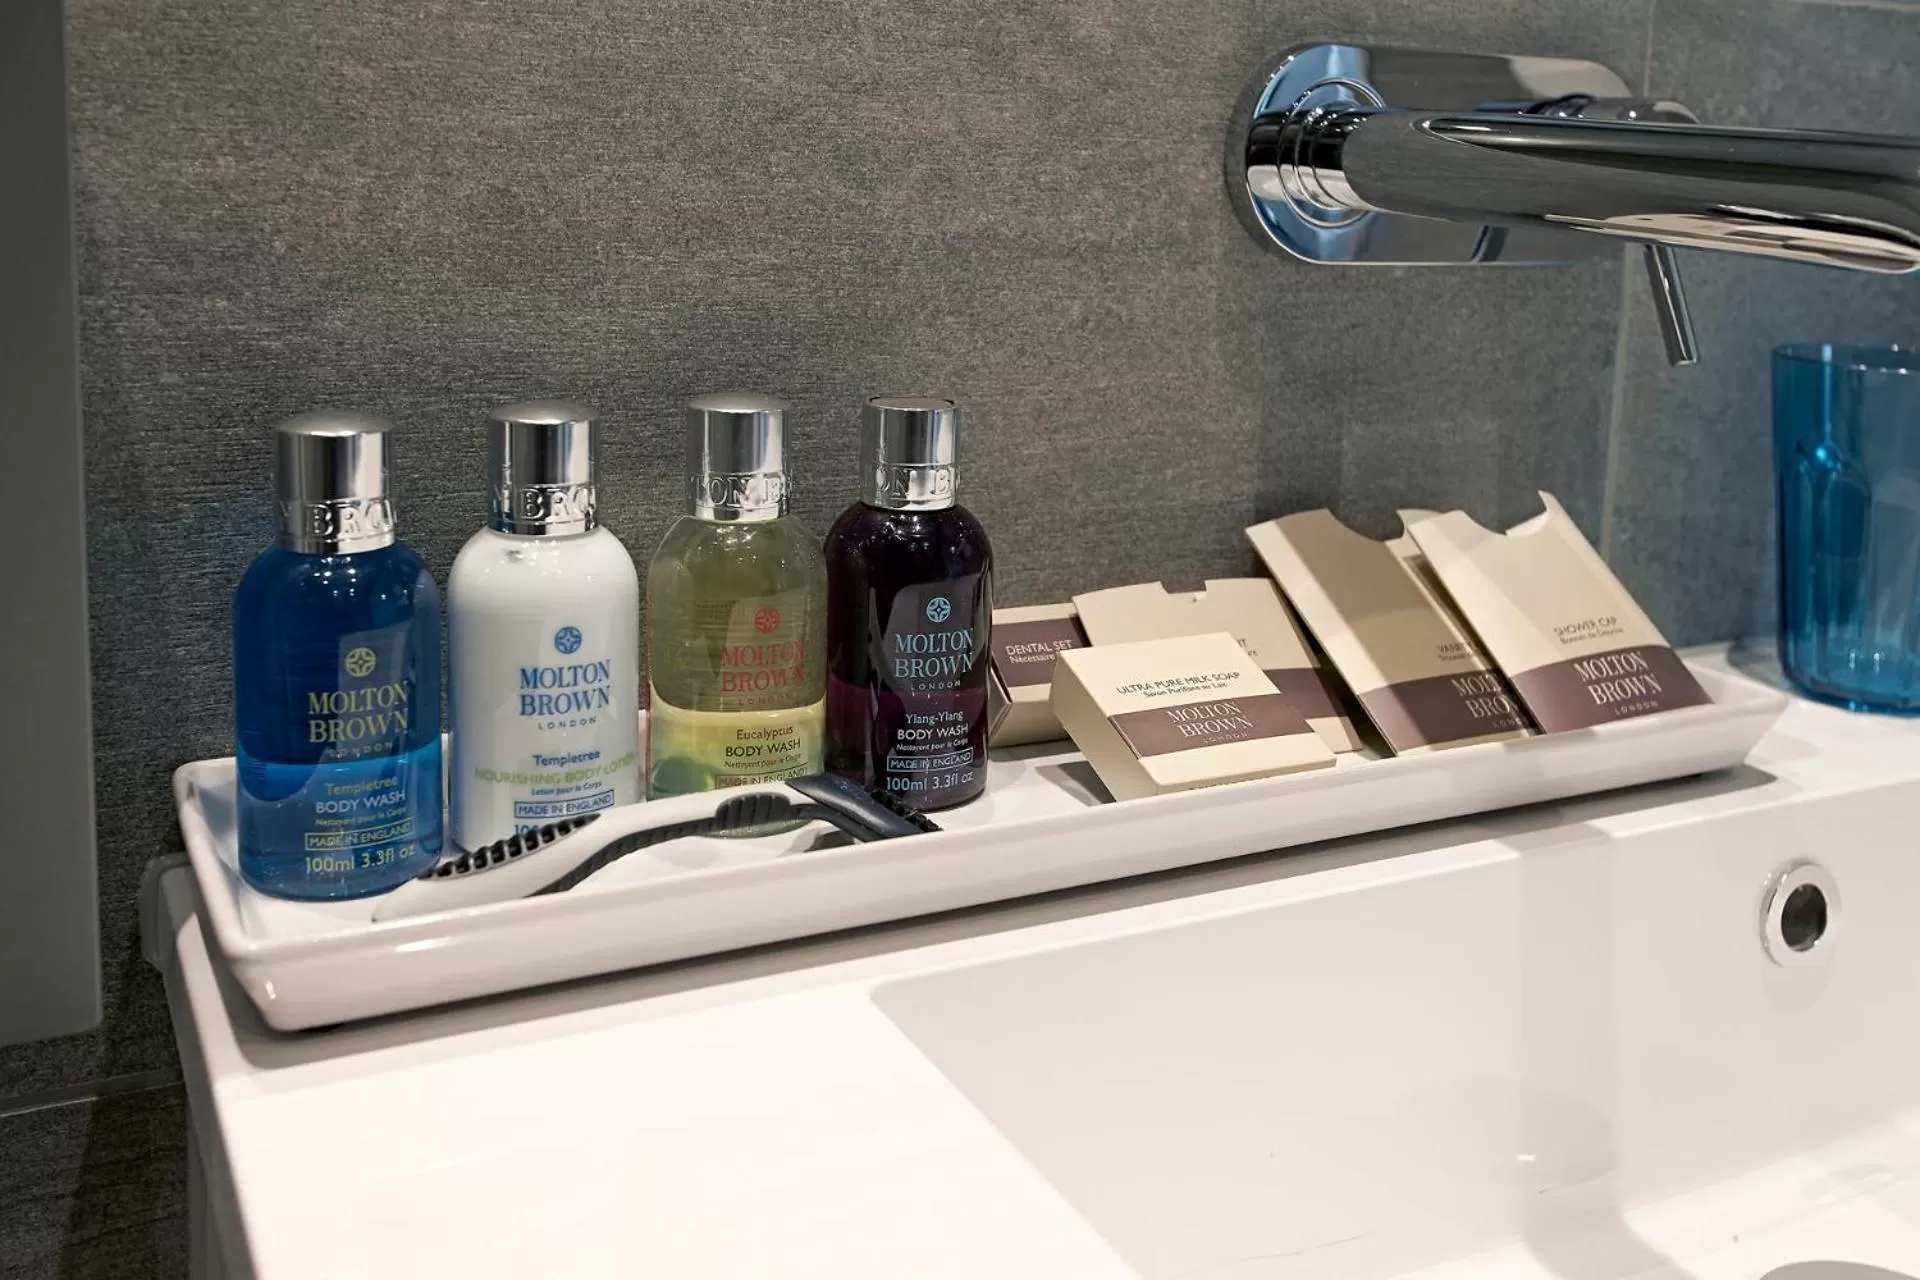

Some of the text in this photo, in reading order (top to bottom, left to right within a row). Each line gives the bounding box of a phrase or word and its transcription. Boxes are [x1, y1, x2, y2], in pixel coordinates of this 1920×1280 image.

[1553, 615, 1618, 637] SHOWER CAP
[895, 627, 974, 654] MOLTON
[1005, 639, 1073, 656] DENTAL SET
[720, 640, 805, 666] MOLTON
[895, 652, 973, 678] BROWN
[520, 659, 611, 689] MOLTON
[721, 664, 805, 693] BROWN
[1572, 650, 1649, 683] MOLTON
[911, 679, 961, 691] LONDON
[1116, 671, 1240, 695] ULTRA PURE MILK SOAP
[1587, 672, 1663, 705] BROWN
[308, 681, 409, 714] MOLTON
[520, 685, 611, 716] BROWN
[1614, 700, 1659, 716] LONDON
[538, 716, 598, 730] LONDON
[905, 711, 964, 726] Ylang-Ylang
[1167, 700, 1242, 724] MOLTON
[309, 707, 408, 743] BROWN
[736, 725, 794, 741] Eucalyptus
[897, 722, 969, 740] BODY WASH
[1177, 714, 1254, 738] BROWN
[533, 750, 601, 767] Templetree
[725, 738, 801, 757] BODY WASH
[890, 751, 972, 769] MADE IN ENGLAND
[324, 776, 399, 796] Templetree
[474, 766, 561, 785] NOURISHING
[564, 768, 600, 784] BODY
[886, 770, 974, 791] 100ml 3.3fl oz
[315, 789, 406, 814] BODY WASH
[518, 793, 612, 815] MADE IN ENGLAND
[309, 821, 412, 848] MADE IN ENGLAND
[306, 843, 416, 875] 100ml 3.3fl oz
